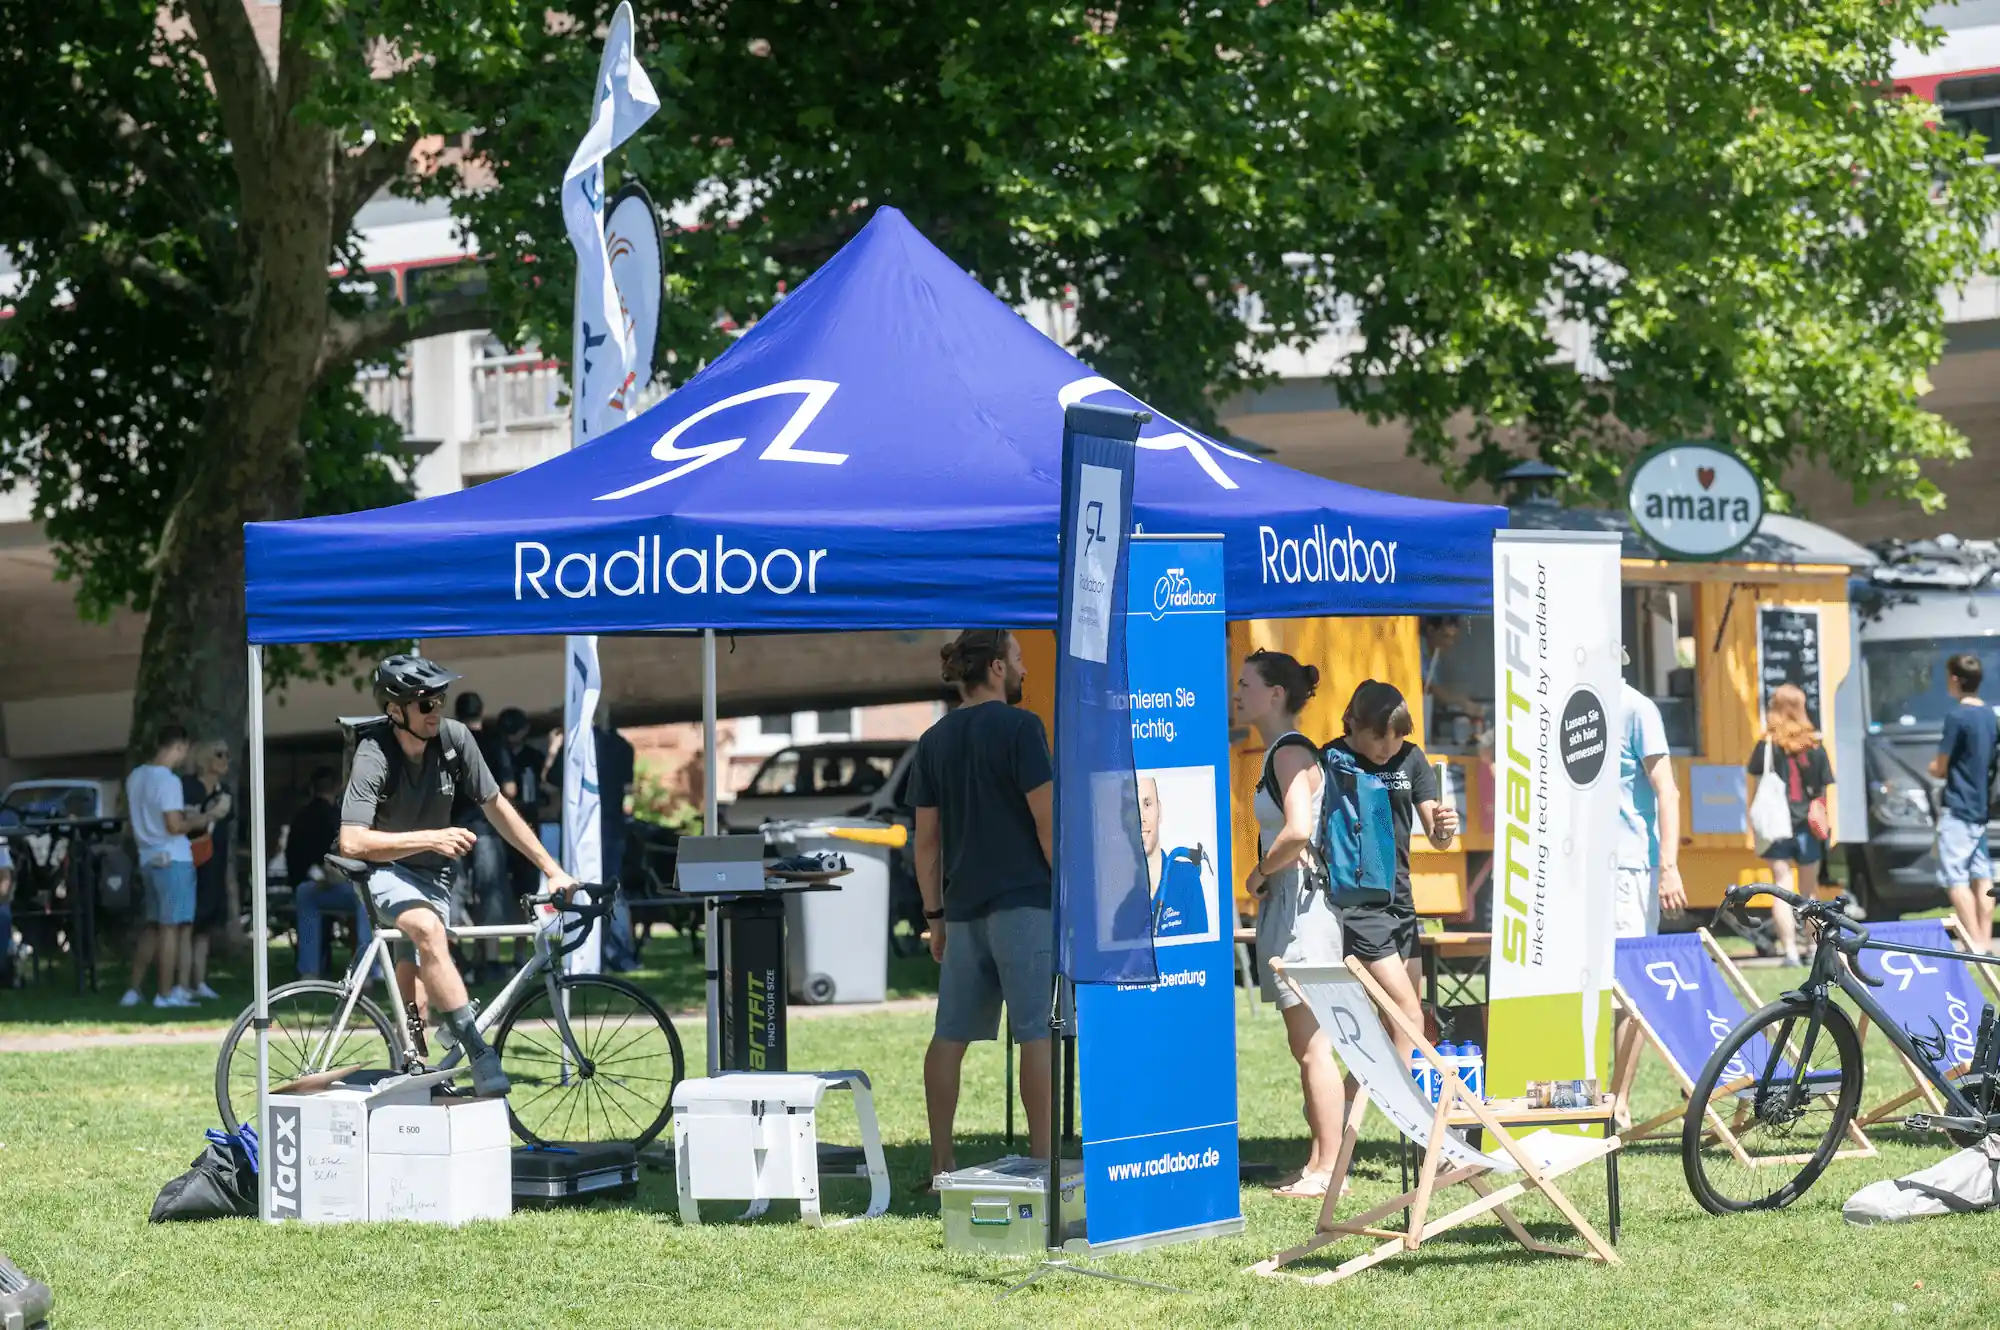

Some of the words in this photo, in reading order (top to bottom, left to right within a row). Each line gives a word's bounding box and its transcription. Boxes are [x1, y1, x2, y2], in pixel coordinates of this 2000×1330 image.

[1645, 492, 1750, 523] amara
[514, 534, 828, 600] Radlabor
[1259, 523, 1398, 585] Radlabor
[1169, 589, 1217, 606] radlabor
[1535, 560, 1548, 660] radlabor
[1536, 668, 1551, 696] by
[1175, 687, 1196, 708] Sie
[1131, 717, 1178, 742] richtig.
[1564, 714, 1588, 732] Lassen
[1588, 709, 1600, 724] Sie
[1569, 730, 1583, 747] sich
[1582, 727, 1598, 742] hier
[1536, 703, 1551, 835] technology
[1531, 844, 1550, 966] bikefitting
[766, 968, 775, 992] SIZE
[766, 992, 776, 1021] YOUR
[767, 1022, 776, 1047] FIND
[398, 1125, 405, 1134] E
[406, 1125, 420, 1134] 500
[270, 1112, 297, 1213] Tacx
[1107, 1146, 1221, 1183] www.radlabor.de
